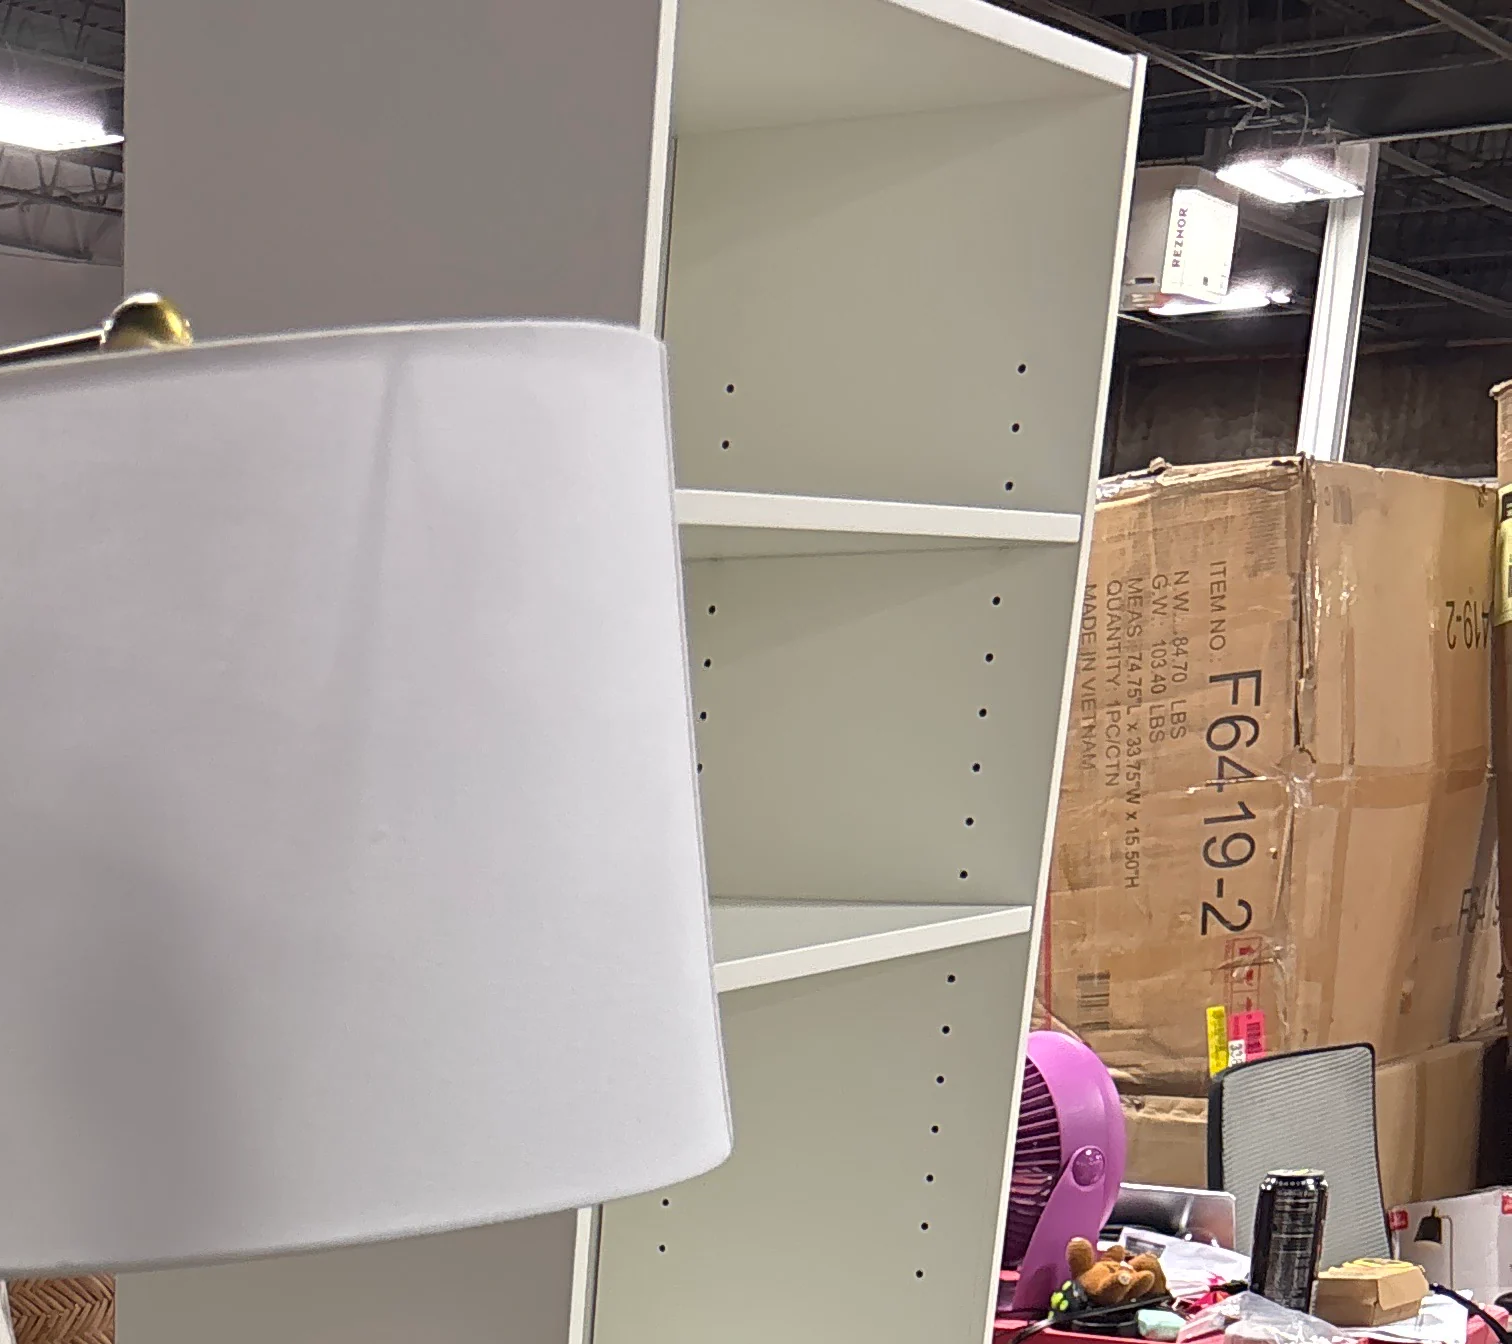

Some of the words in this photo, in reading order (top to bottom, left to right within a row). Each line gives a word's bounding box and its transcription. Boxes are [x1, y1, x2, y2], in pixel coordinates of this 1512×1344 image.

[1172, 208, 1188, 267] REZNOR
[1081, 584, 1097, 645] MADE
[1210, 560, 1226, 613] ITEM
[1080, 652, 1096, 671] IN
[1106, 580, 1122, 691] QUANTITY:
[1172, 636, 1188, 682] 84.70
[1150, 640, 1167, 694] 103.40
[1081, 677, 1097, 770] VIETNAM
[1106, 700, 1122, 786] 1PC/CTN
[1149, 704, 1165, 743] LBS
[1170, 699, 1187, 739] LBS
[1201, 670, 1262, 935] F6419-2
